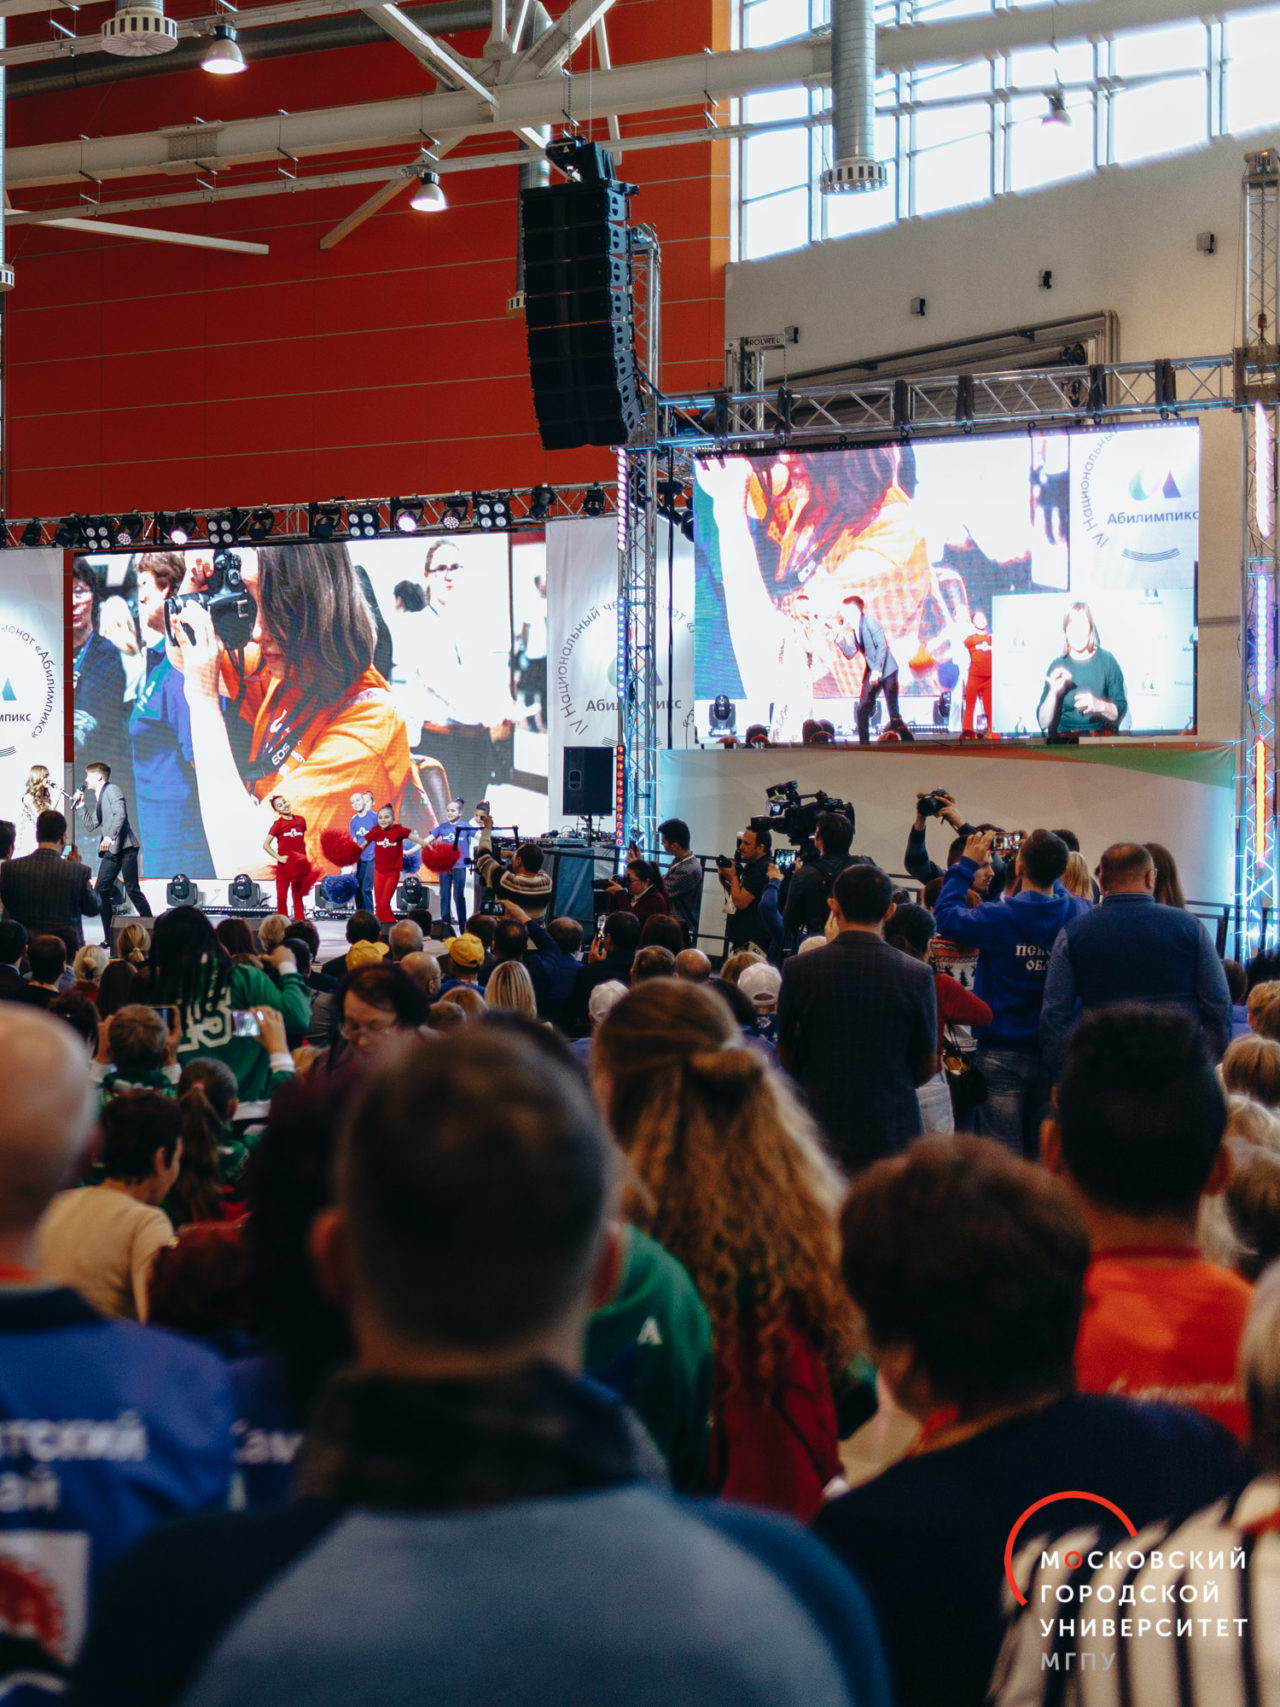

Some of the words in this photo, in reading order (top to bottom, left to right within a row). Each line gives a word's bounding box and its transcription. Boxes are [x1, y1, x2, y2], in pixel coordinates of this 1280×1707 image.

[1080, 431, 1118, 532] Национальны
[1107, 510, 1199, 524] Абилимпикс
[35, 645, 56, 739] «Абилимпикс»
[558, 607, 601, 718] Национальный
[570, 719, 589, 736] IV
